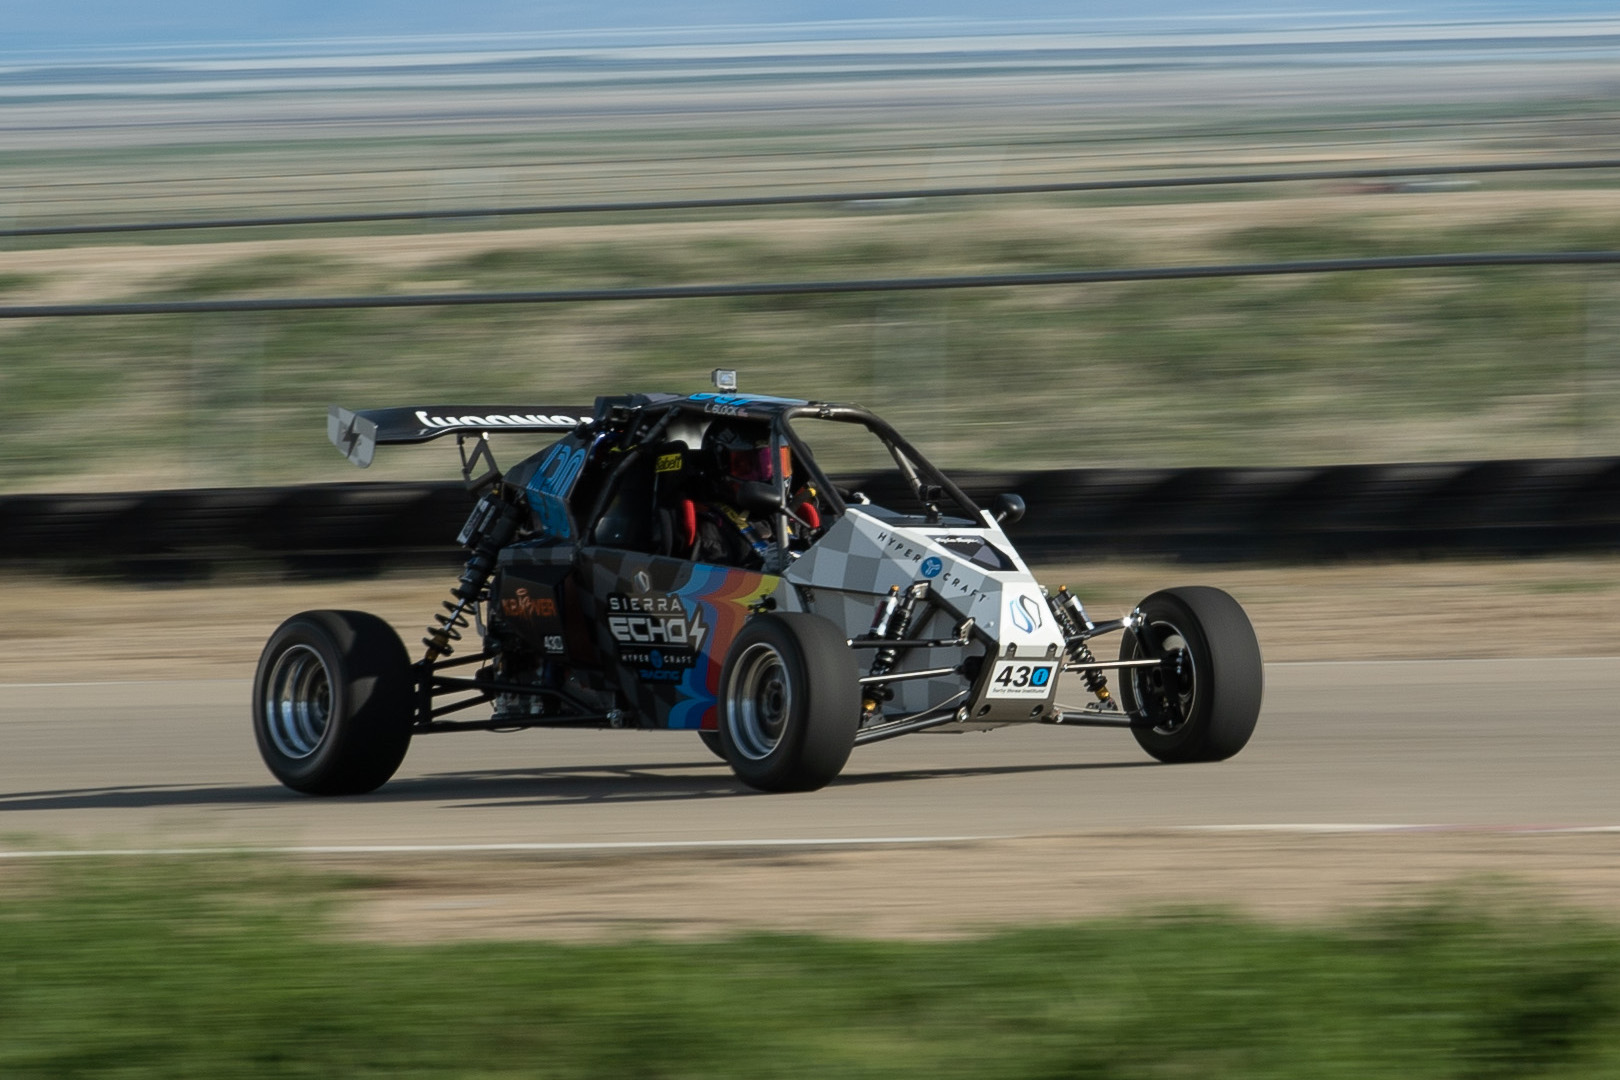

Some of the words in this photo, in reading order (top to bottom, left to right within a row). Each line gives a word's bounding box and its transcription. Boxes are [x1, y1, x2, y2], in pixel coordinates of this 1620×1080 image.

[877, 531, 922, 562] HYPER
[942, 572, 987, 603] CRAFT
[610, 597, 682, 612] SIERRA
[608, 617, 688, 643] ECHO
[663, 655, 693, 664] CRAFT
